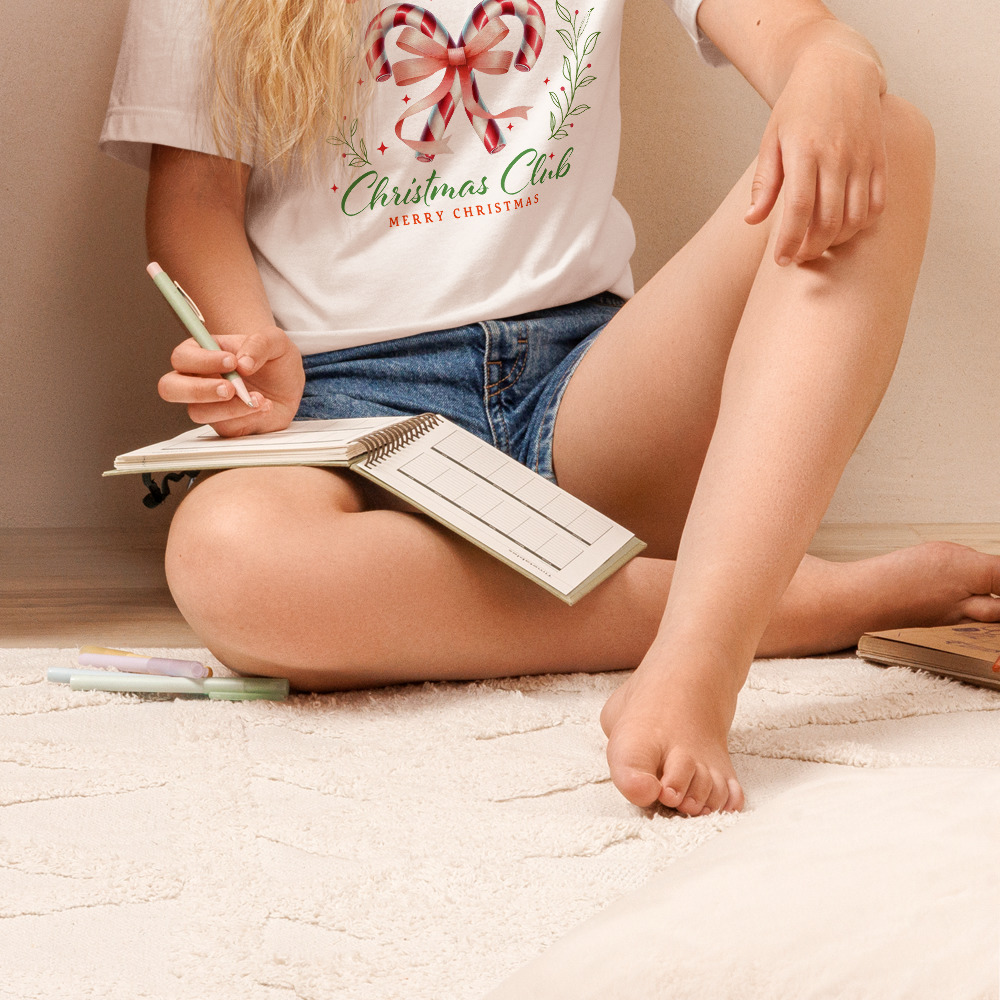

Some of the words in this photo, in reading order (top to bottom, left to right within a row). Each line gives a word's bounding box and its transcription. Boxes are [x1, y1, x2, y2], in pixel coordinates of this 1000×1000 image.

[341, 169, 490, 217] Christmas
[500, 147, 574, 196] Club
[388, 210, 445, 228] MERRY
[452, 193, 541, 219] CHRISTMAS
